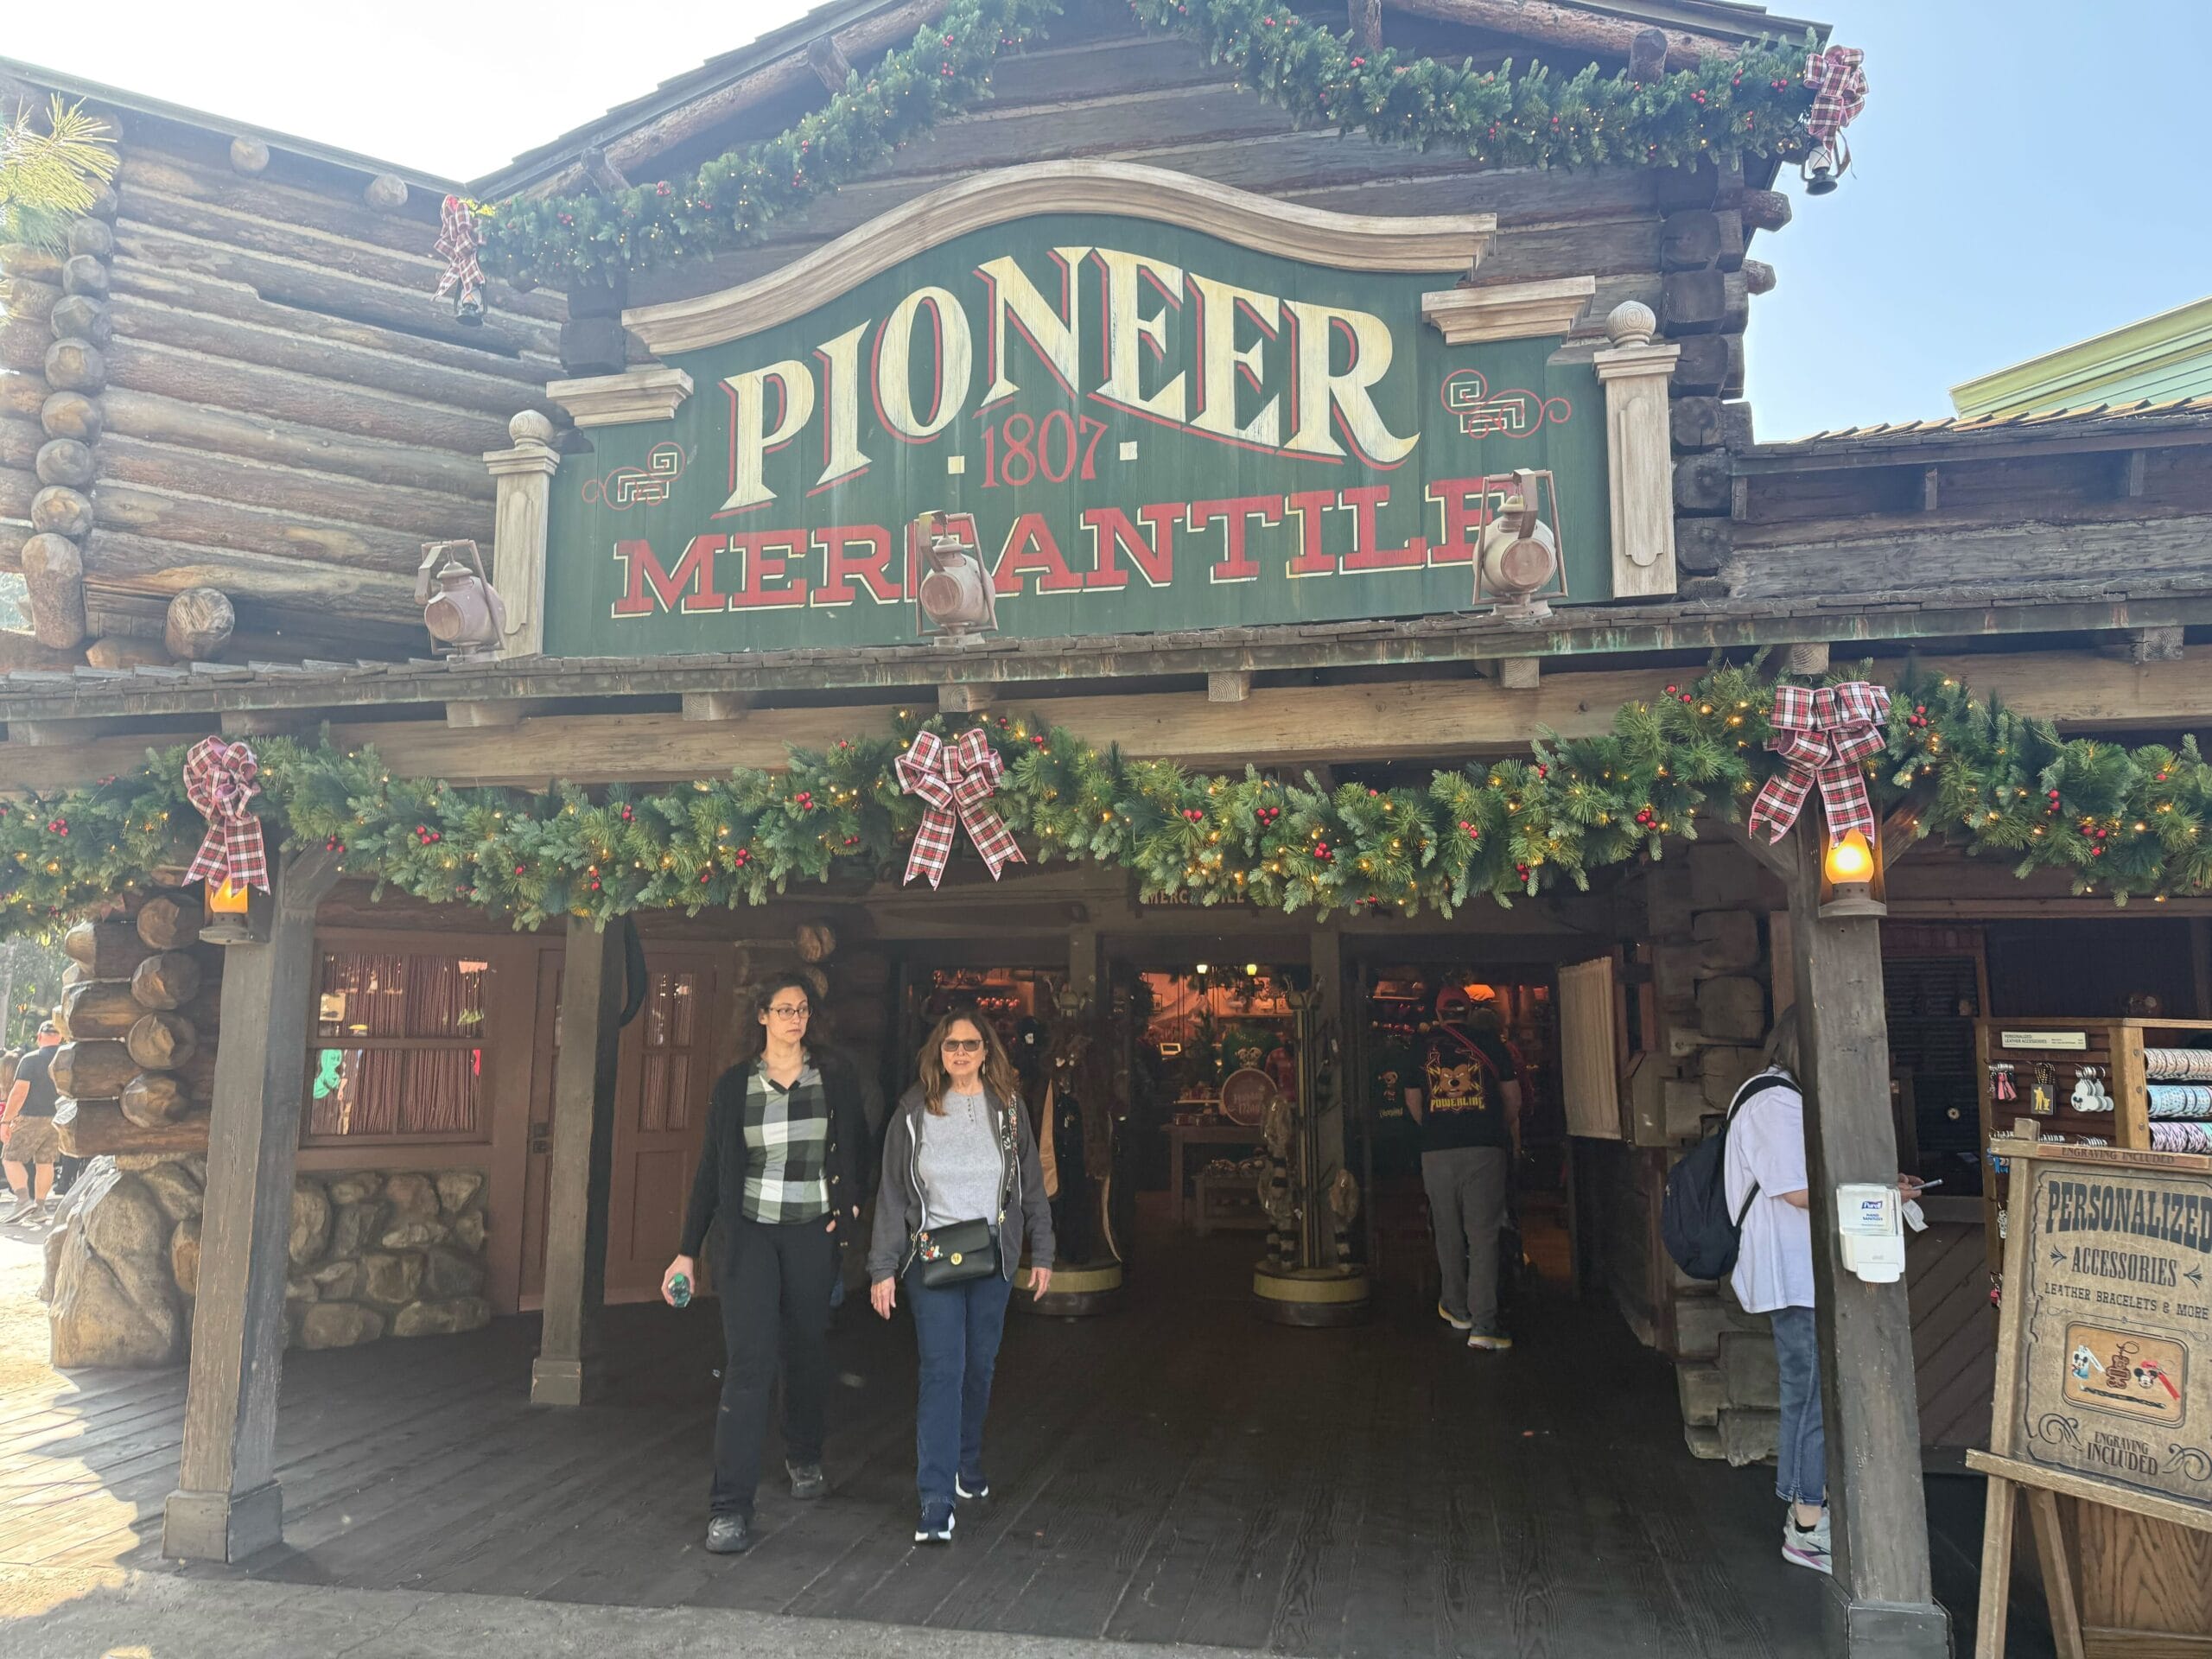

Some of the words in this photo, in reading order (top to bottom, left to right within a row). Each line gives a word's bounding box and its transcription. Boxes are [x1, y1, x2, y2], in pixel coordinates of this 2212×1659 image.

[712, 245, 1421, 518] PIONEER
[981, 410, 1109, 488] 1807
[1430, 1096, 1485, 1113] POWERLINE
[2062, 1147, 2117, 1160] ENGRAVING
[2122, 1152, 2175, 1165] INCLUDED
[2045, 1180, 2212, 1254] PERSONALIZED
[2071, 1246, 2177, 1287] ACCESSORIES
[2044, 1282, 2091, 1300] LEATHER
[2096, 1290, 2158, 1312] BRACELETS
[2163, 1301, 2171, 1314] &
[2176, 1303, 2209, 1320] MORE
[2088, 1441, 2158, 1476] INCLUDED
[2094, 1431, 2149, 1455] ENGRAVING
